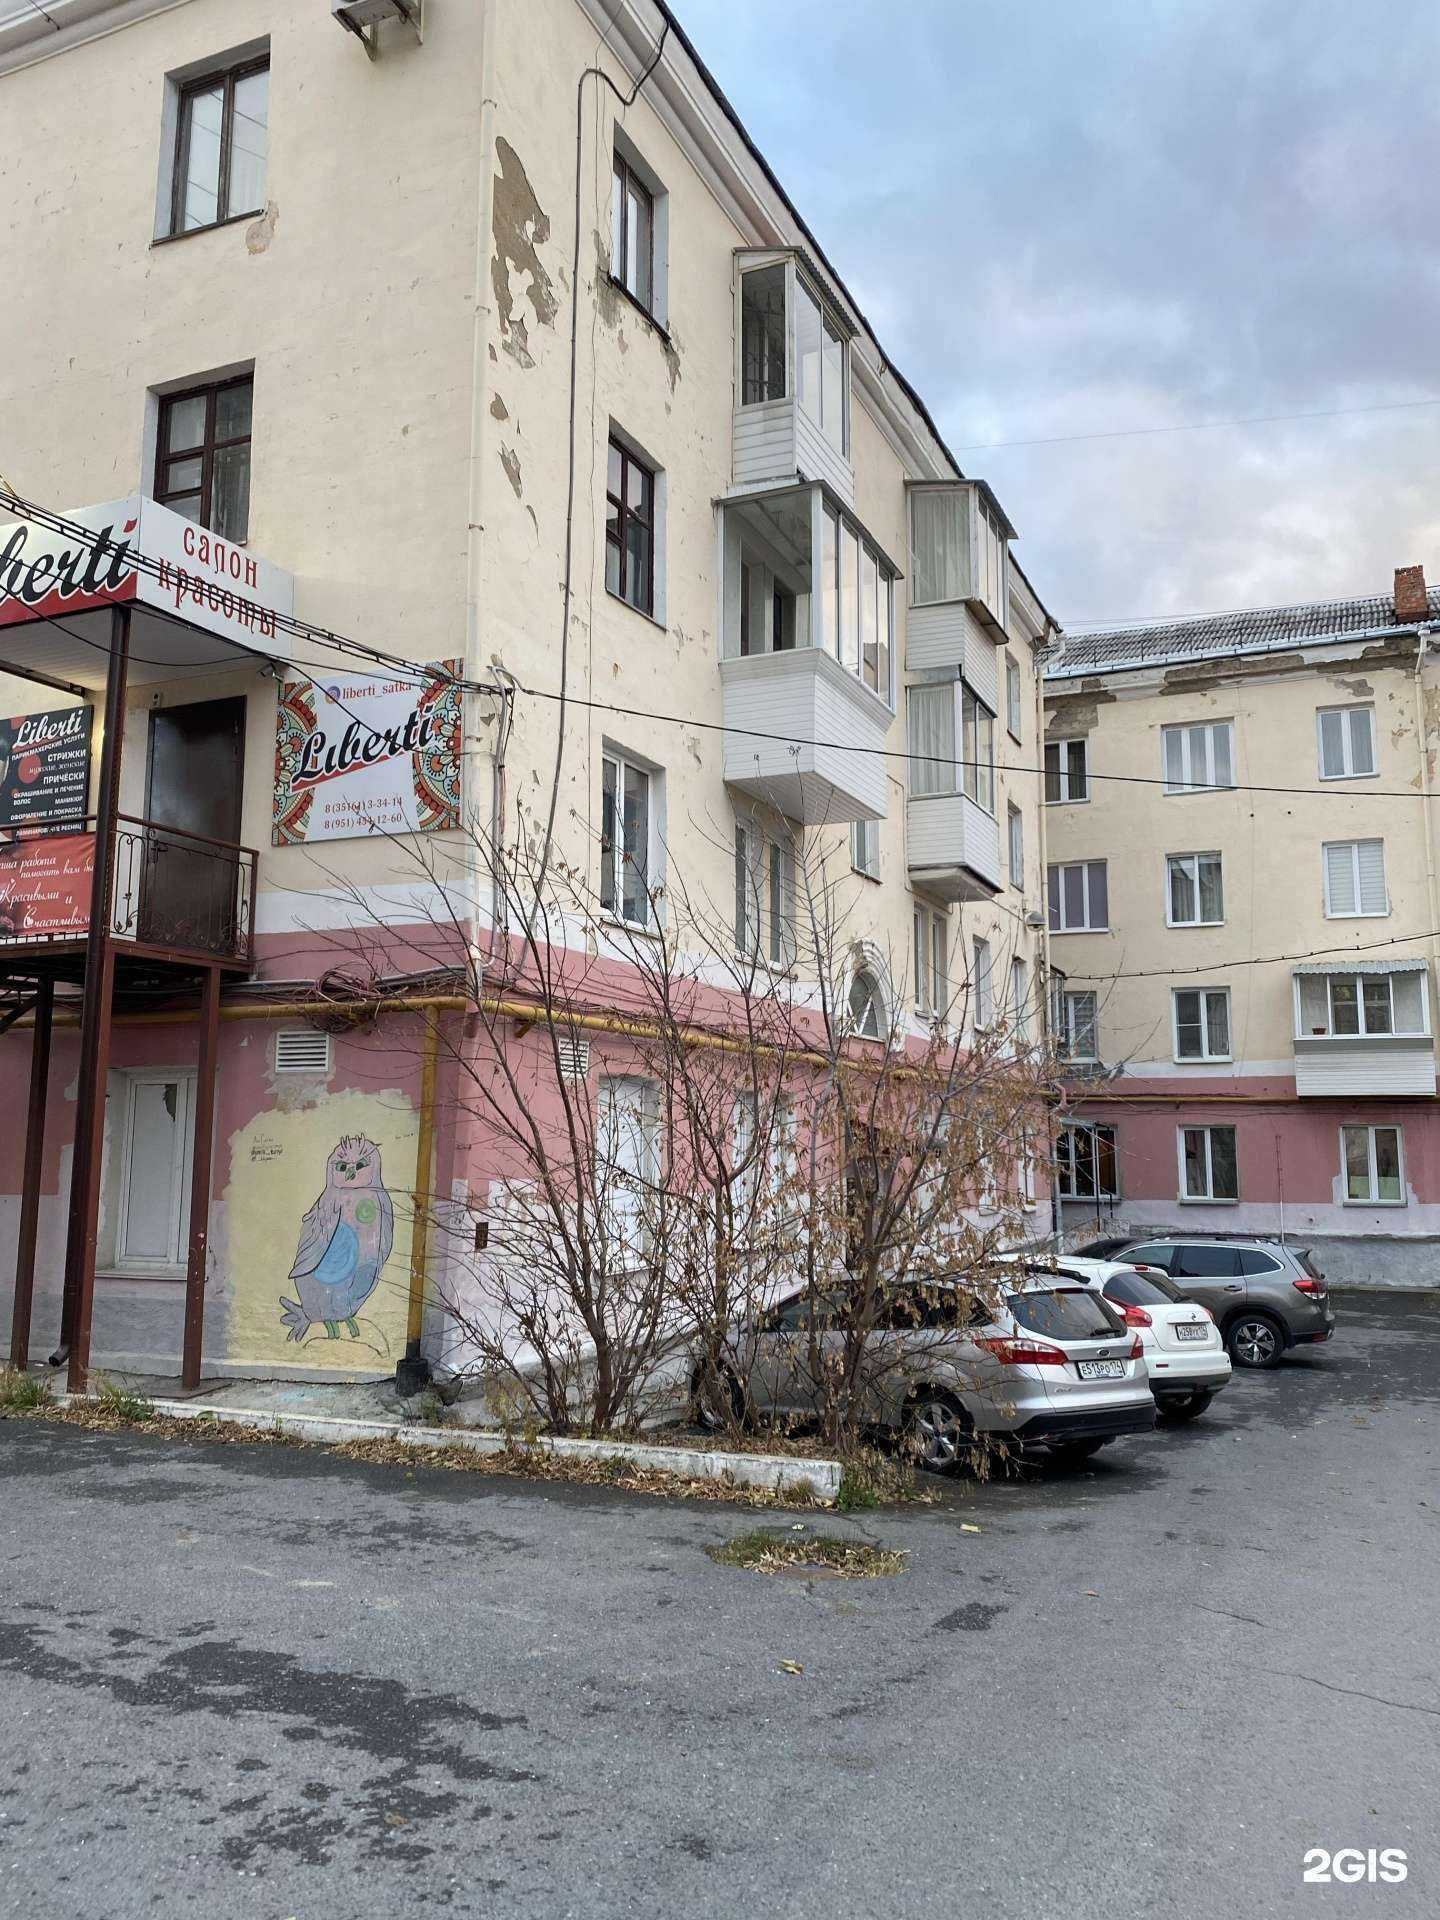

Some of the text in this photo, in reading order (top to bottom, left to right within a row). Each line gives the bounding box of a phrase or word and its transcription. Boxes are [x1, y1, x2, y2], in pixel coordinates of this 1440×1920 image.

[0, 517, 138, 602] berti
[183, 526, 259, 589] салон
[158, 556, 277, 640] красоты
[12, 710, 83, 749] Liberti
[12, 733, 85, 761] ПАРИКМАХЕРСКИЕ УСЛУГИ
[48, 749, 86, 762] СТРИЖКИ
[291, 703, 434, 784] Liberti
[43, 771, 85, 785] ПРИЧЕСКИ
[13, 788, 53, 799] ОКРАШИВАНИЕ
[59, 784, 84, 793] ЛЕЧЕНИЕ
[13, 795, 83, 806] ВОЛОС МАНИКЮР
[53, 806, 83, 815] ПОКРАСКА
[19, 848, 56, 873] работа
[0, 879, 73, 909] Красивыми и
[23, 904, 90, 929] Счастливым
